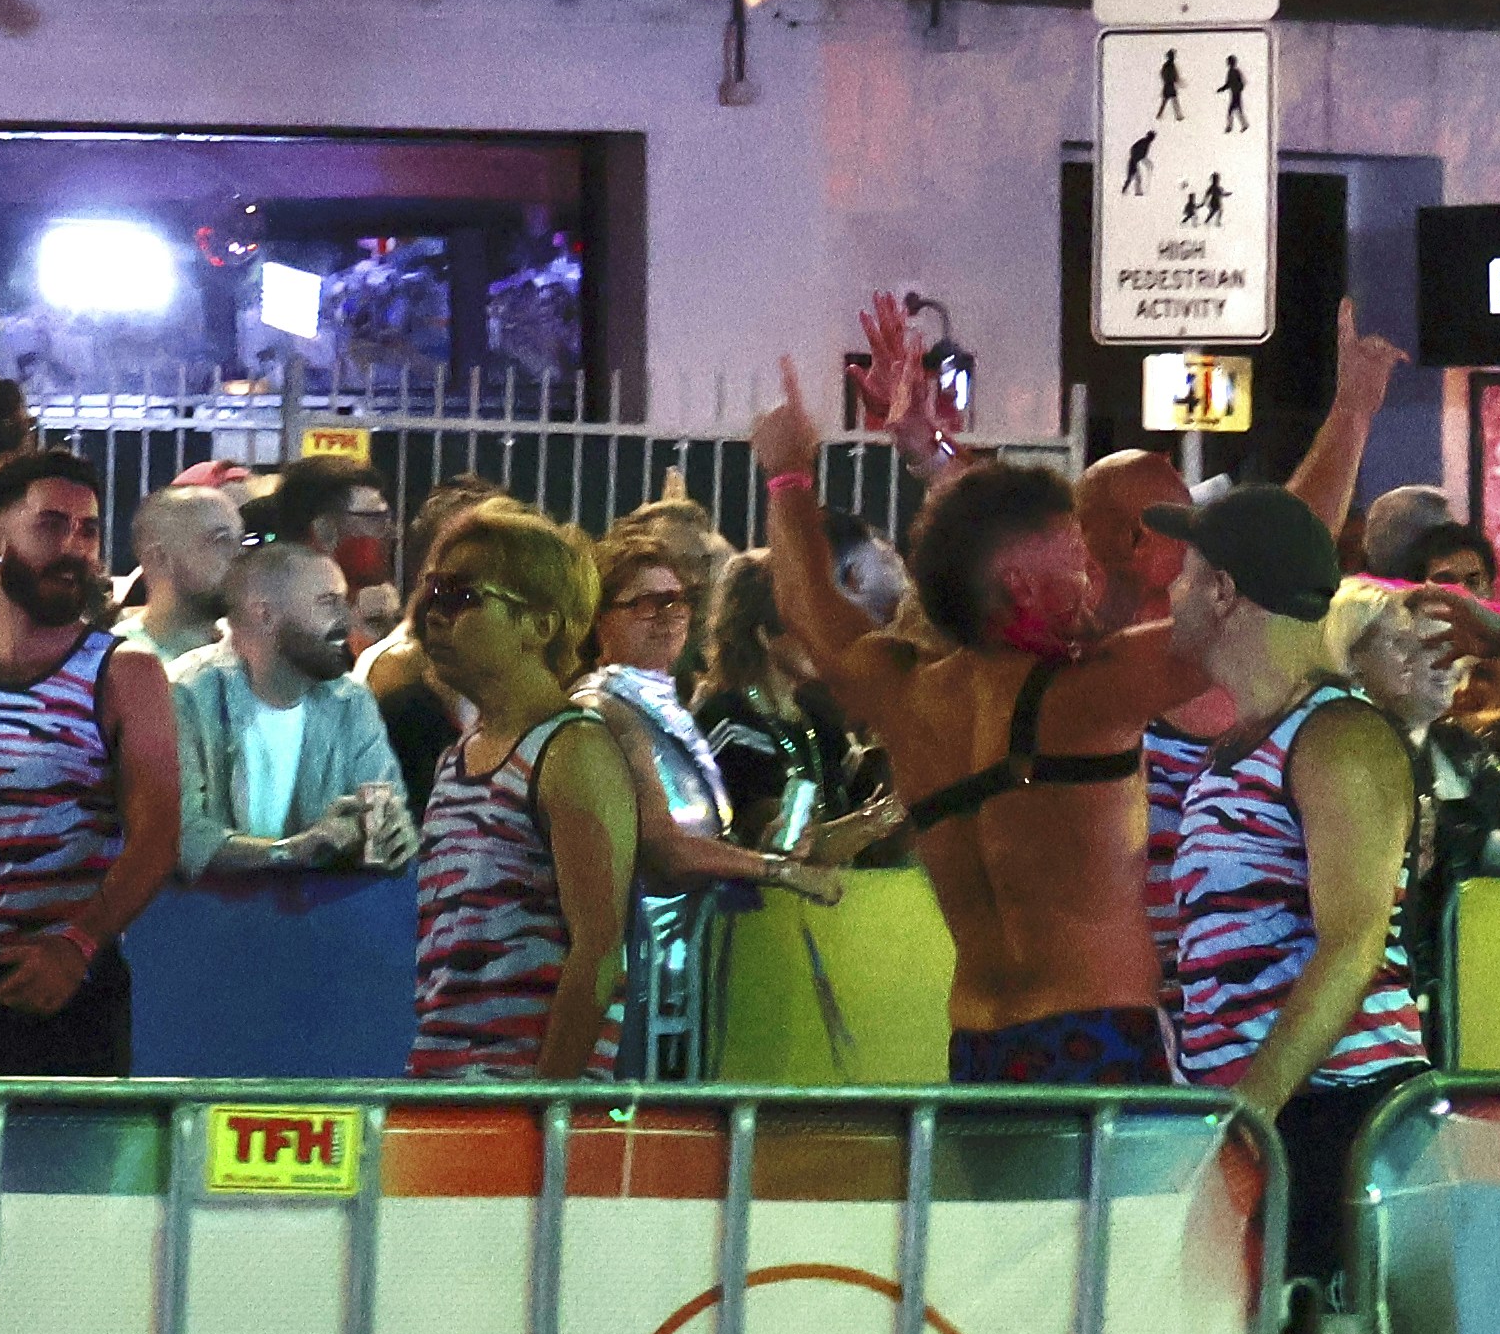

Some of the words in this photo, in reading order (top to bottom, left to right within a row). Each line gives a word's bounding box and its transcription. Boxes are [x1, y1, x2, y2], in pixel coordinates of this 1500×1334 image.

[1157, 240, 1206, 261] HIGH
[1118, 269, 1246, 290] PEDESTRIAN
[1136, 298, 1227, 320] ACTIVITY
[227, 1117, 334, 1165] TFH
